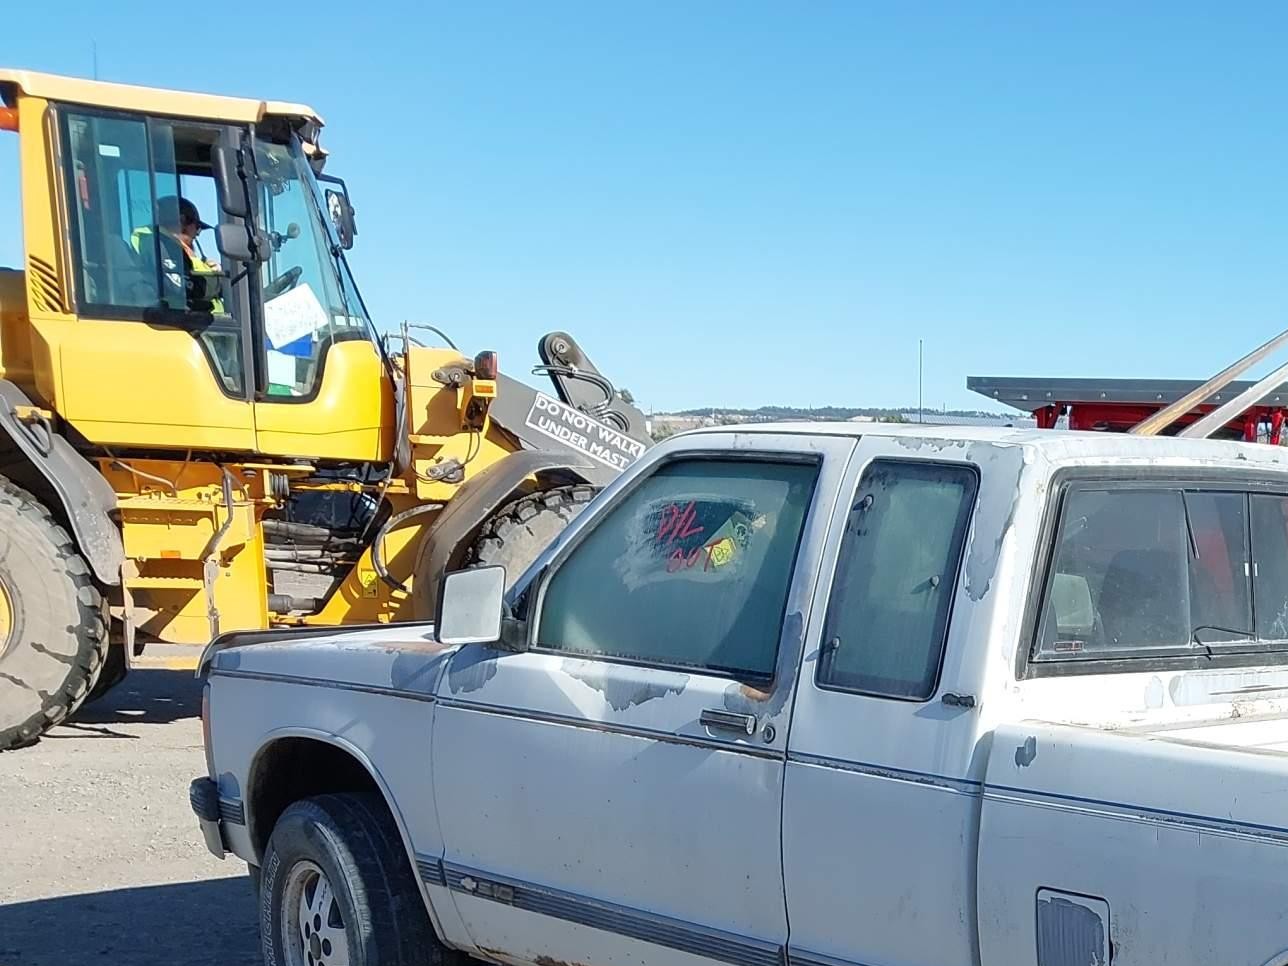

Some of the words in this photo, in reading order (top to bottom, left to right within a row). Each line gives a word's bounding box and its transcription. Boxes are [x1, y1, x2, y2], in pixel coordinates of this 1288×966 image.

[535, 396, 560, 416] DO
[562, 410, 598, 434] NOT
[598, 430, 640, 458] WALK
[538, 416, 589, 449] UNDER
[589, 441, 629, 468] MAST
